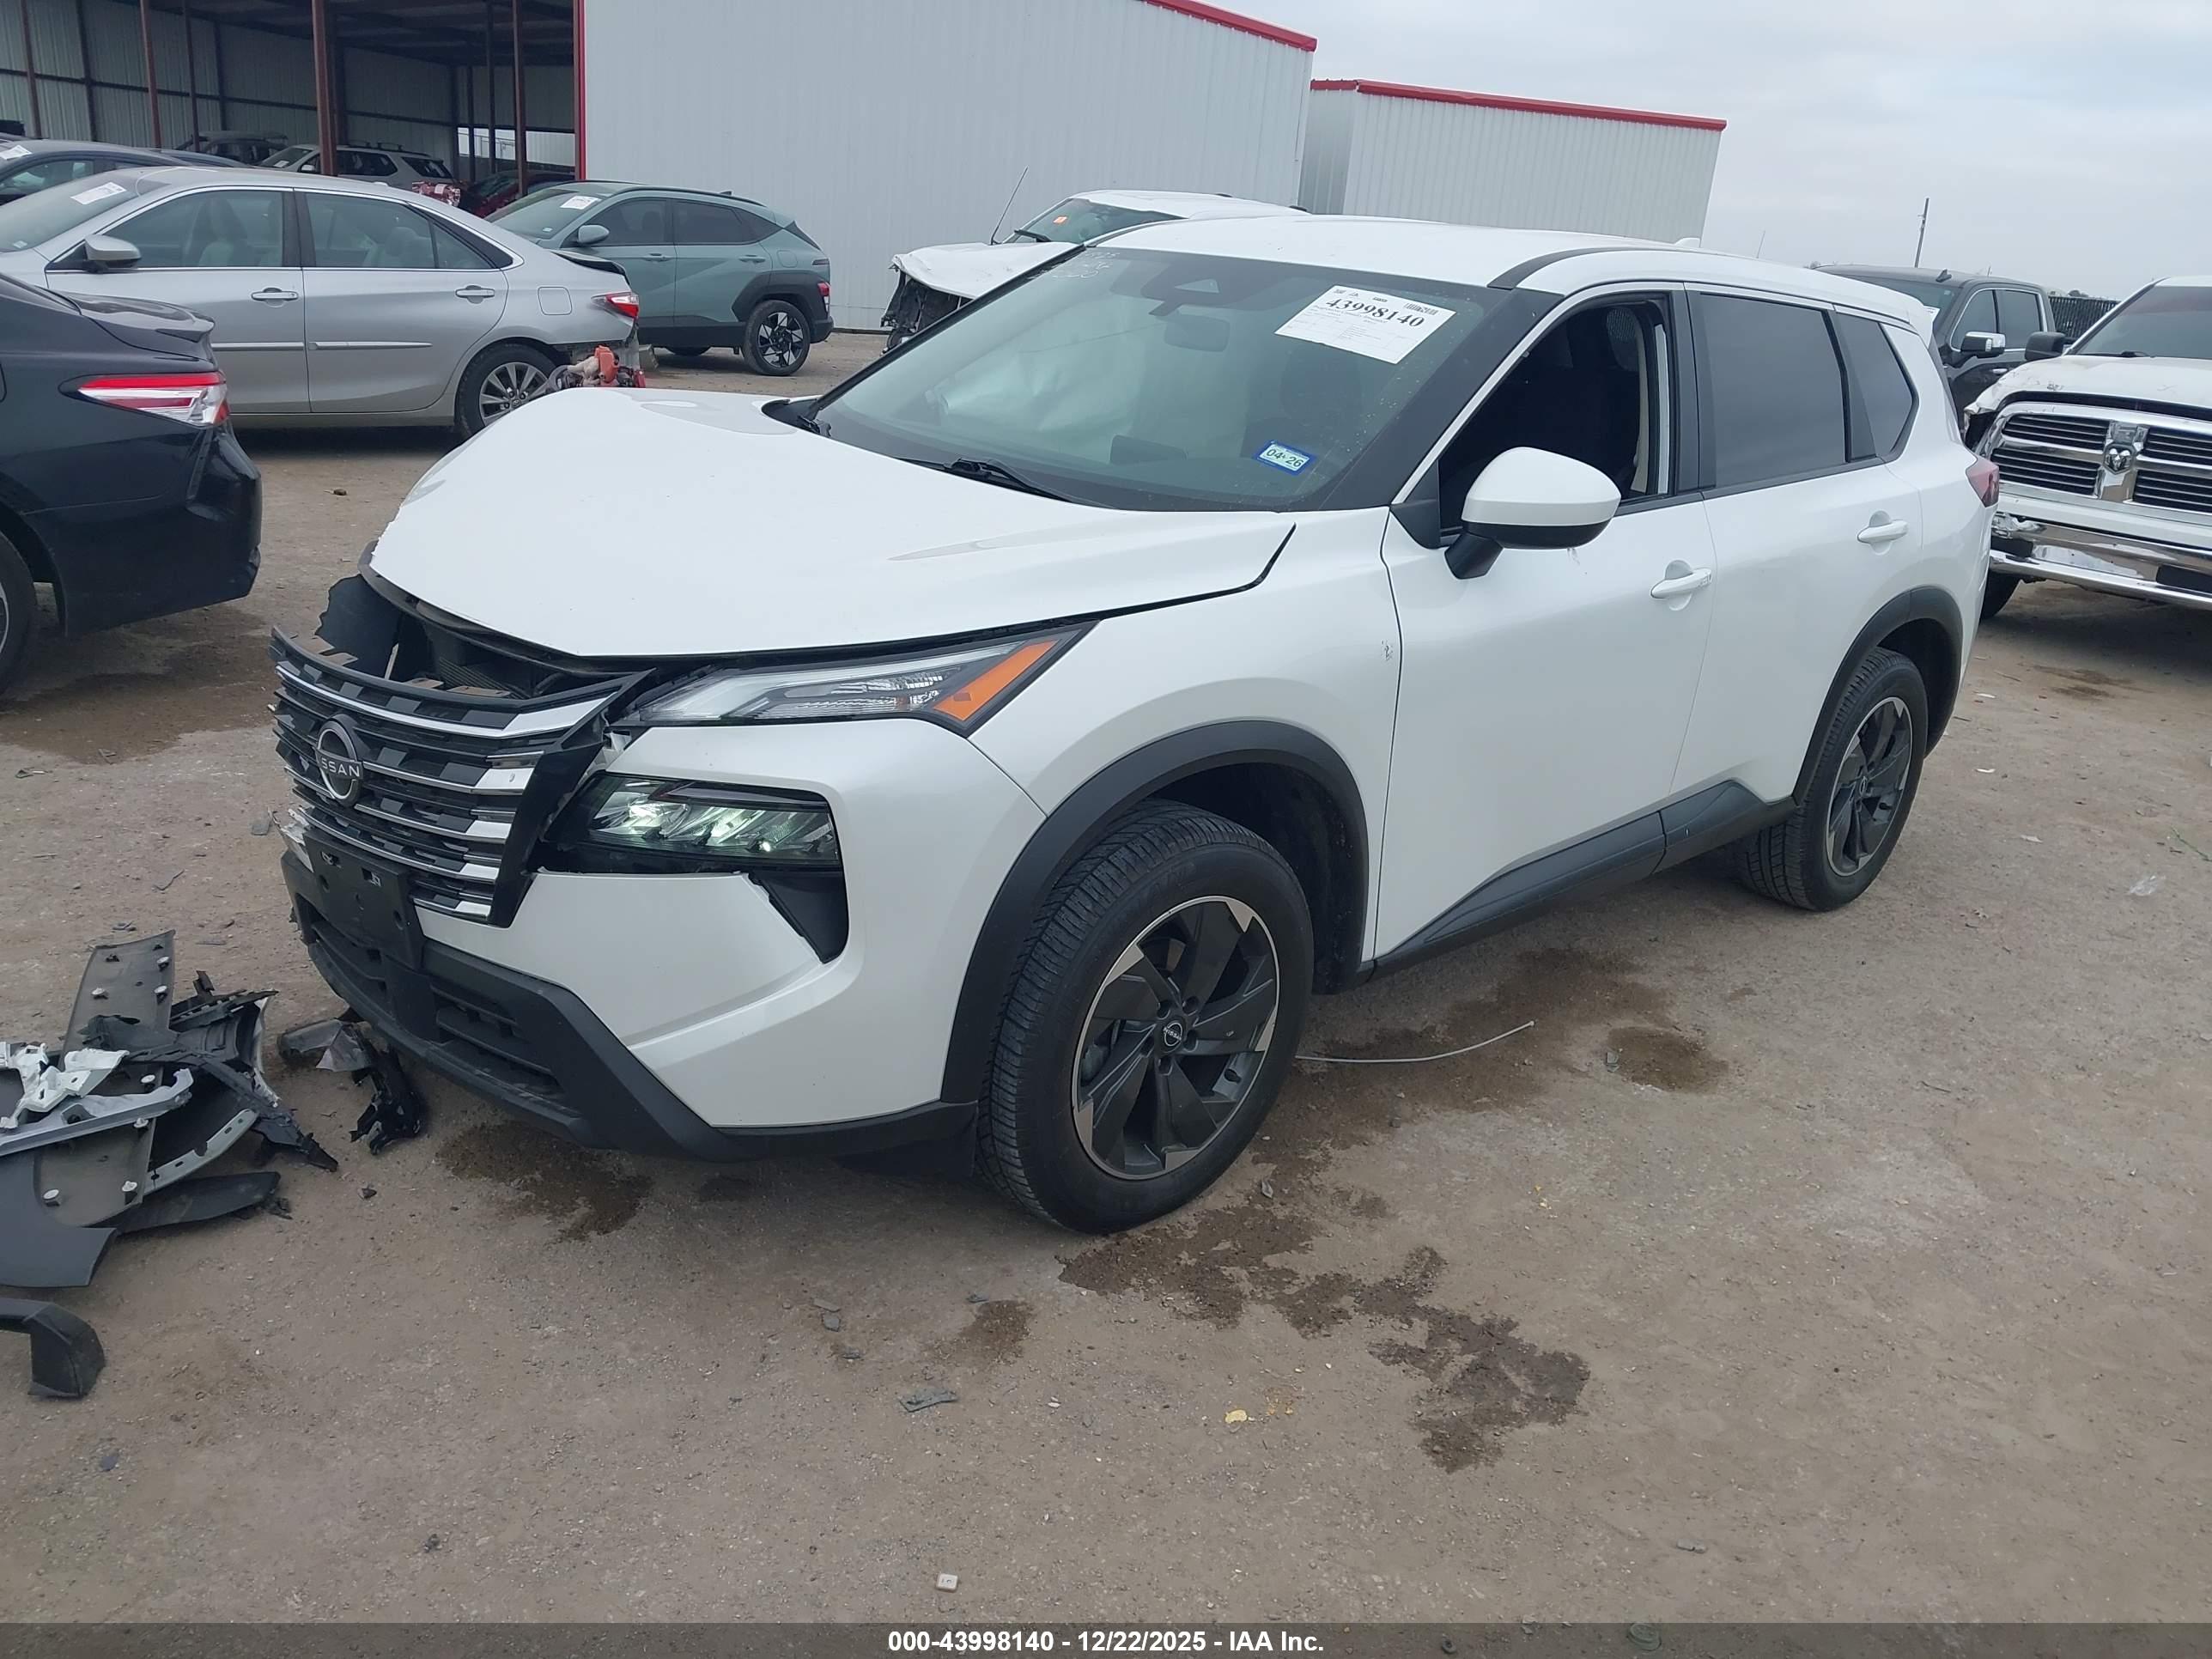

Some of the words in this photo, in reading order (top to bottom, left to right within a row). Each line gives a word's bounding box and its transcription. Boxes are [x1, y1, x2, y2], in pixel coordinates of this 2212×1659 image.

[1326, 298, 1425, 327] 43998140
[1267, 448, 1284, 459] 04
[1285, 456, 1304, 468] 26
[320, 757, 360, 777] SSAN
